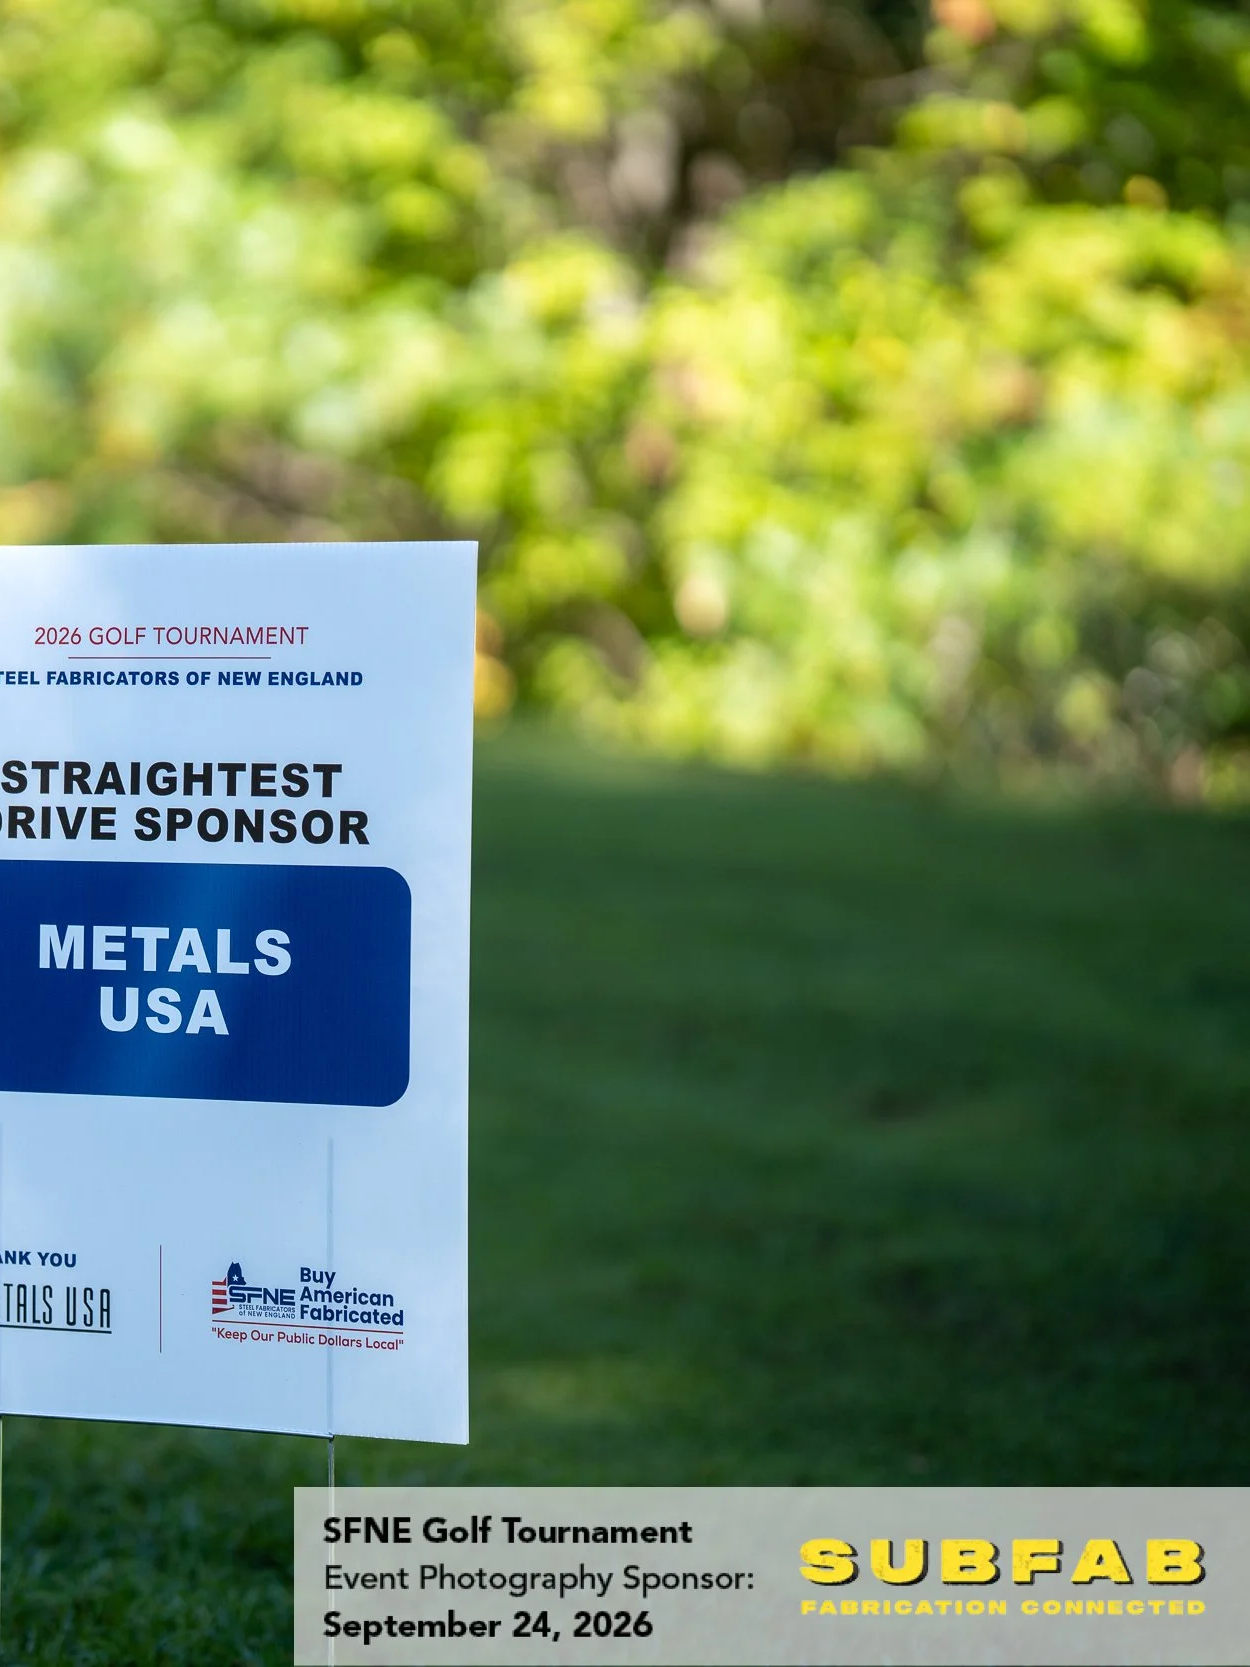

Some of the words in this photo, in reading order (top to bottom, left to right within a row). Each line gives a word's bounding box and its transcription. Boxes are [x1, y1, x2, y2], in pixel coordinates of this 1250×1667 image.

[34, 626, 82, 646] 2026
[89, 626, 147, 646] GOLF
[153, 626, 309, 646] TOURNAMENT
[46, 670, 180, 687] FABRICATORS
[185, 671, 212, 687] OF
[217, 671, 261, 687] NEW
[268, 671, 363, 687] ENGLAND
[0, 759, 343, 798] STRAIGHTEST
[133, 807, 370, 845] SPONSOR
[38, 923, 292, 977] METALS
[99, 986, 230, 1037] USA
[37, 1251, 77, 1268] YOU
[300, 1266, 336, 1289] Buy
[228, 1285, 296, 1306] SFNE
[300, 1286, 394, 1307] American
[66, 1286, 111, 1328] USA
[255, 1305, 296, 1313] FABRICATORS
[264, 1311, 296, 1319] ENGLAND
[300, 1304, 404, 1326] Fabricated
[212, 1327, 248, 1343] "Keep
[250, 1329, 275, 1342] Our
[277, 1331, 315, 1345] Public
[318, 1333, 362, 1348] Dollars
[365, 1337, 404, 1350] Local"
